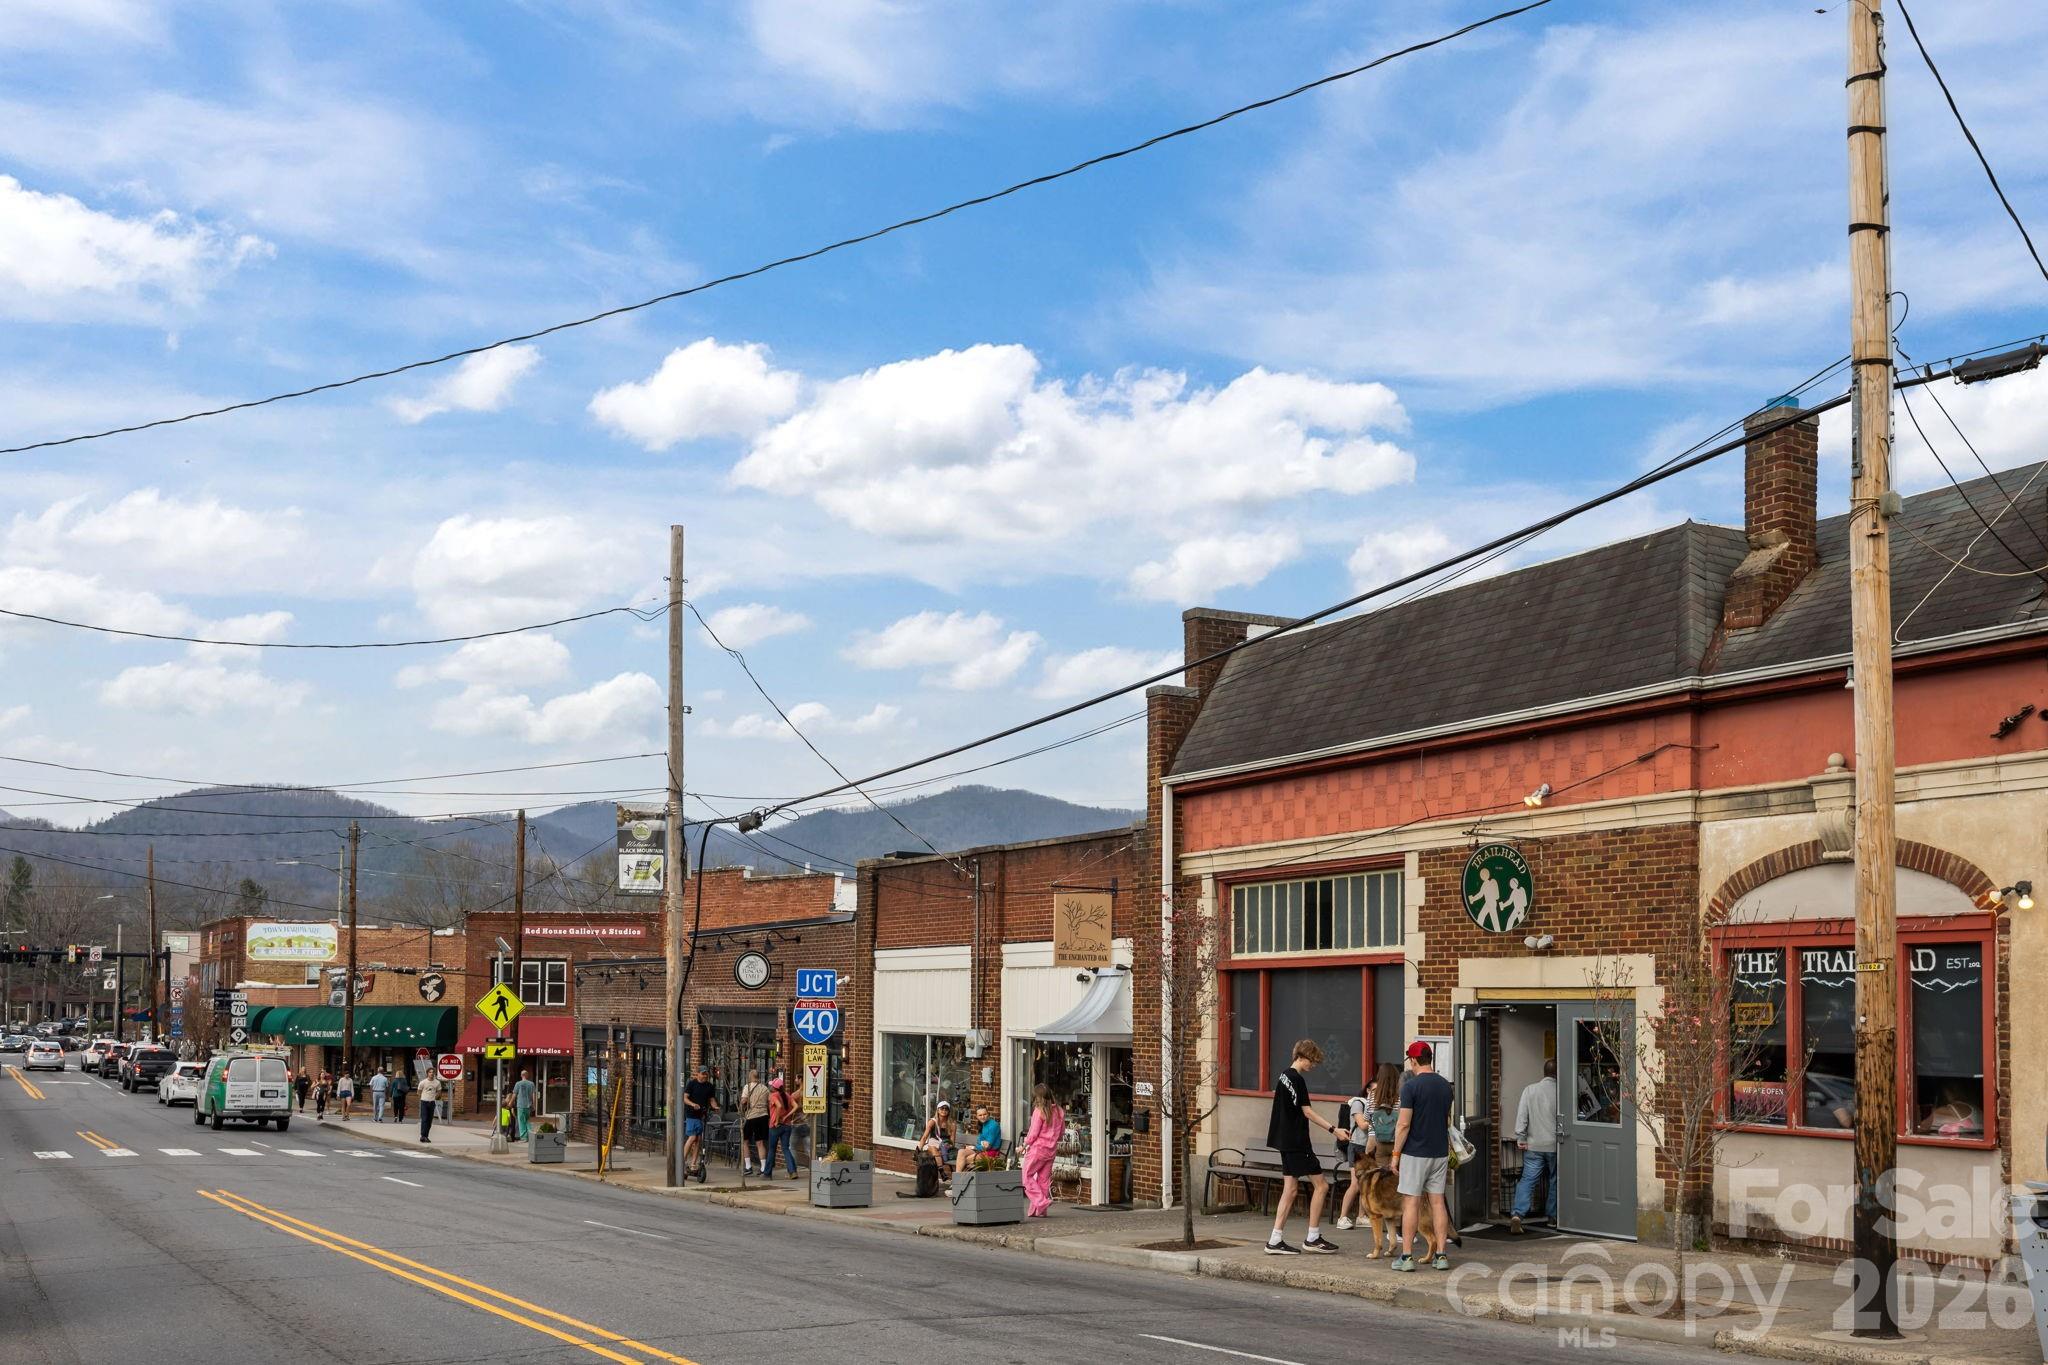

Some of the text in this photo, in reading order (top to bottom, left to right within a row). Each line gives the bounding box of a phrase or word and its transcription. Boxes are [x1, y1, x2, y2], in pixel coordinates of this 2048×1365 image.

[1471, 846, 1527, 874] TRAILHEAD
[262, 925, 282, 934] TOWN
[525, 927, 541, 935] Red
[542, 927, 567, 935] House
[568, 927, 600, 937] Gallery
[608, 927, 642, 936] Studios
[1058, 953, 1109, 962] THE ENCHANTED OAK
[1735, 952, 1778, 974] THE
[1946, 957, 1970, 969] EST
[800, 974, 834, 993] JCT
[233, 1004, 246, 1014] 70
[800, 1001, 832, 1009] INTERSTATE
[232, 1018, 245, 1026] JCT
[798, 1010, 834, 1035] 40
[236, 1032, 241, 1040] 9
[805, 1047, 826, 1055] STATE
[1083, 1060, 1091, 1093] OPEN
